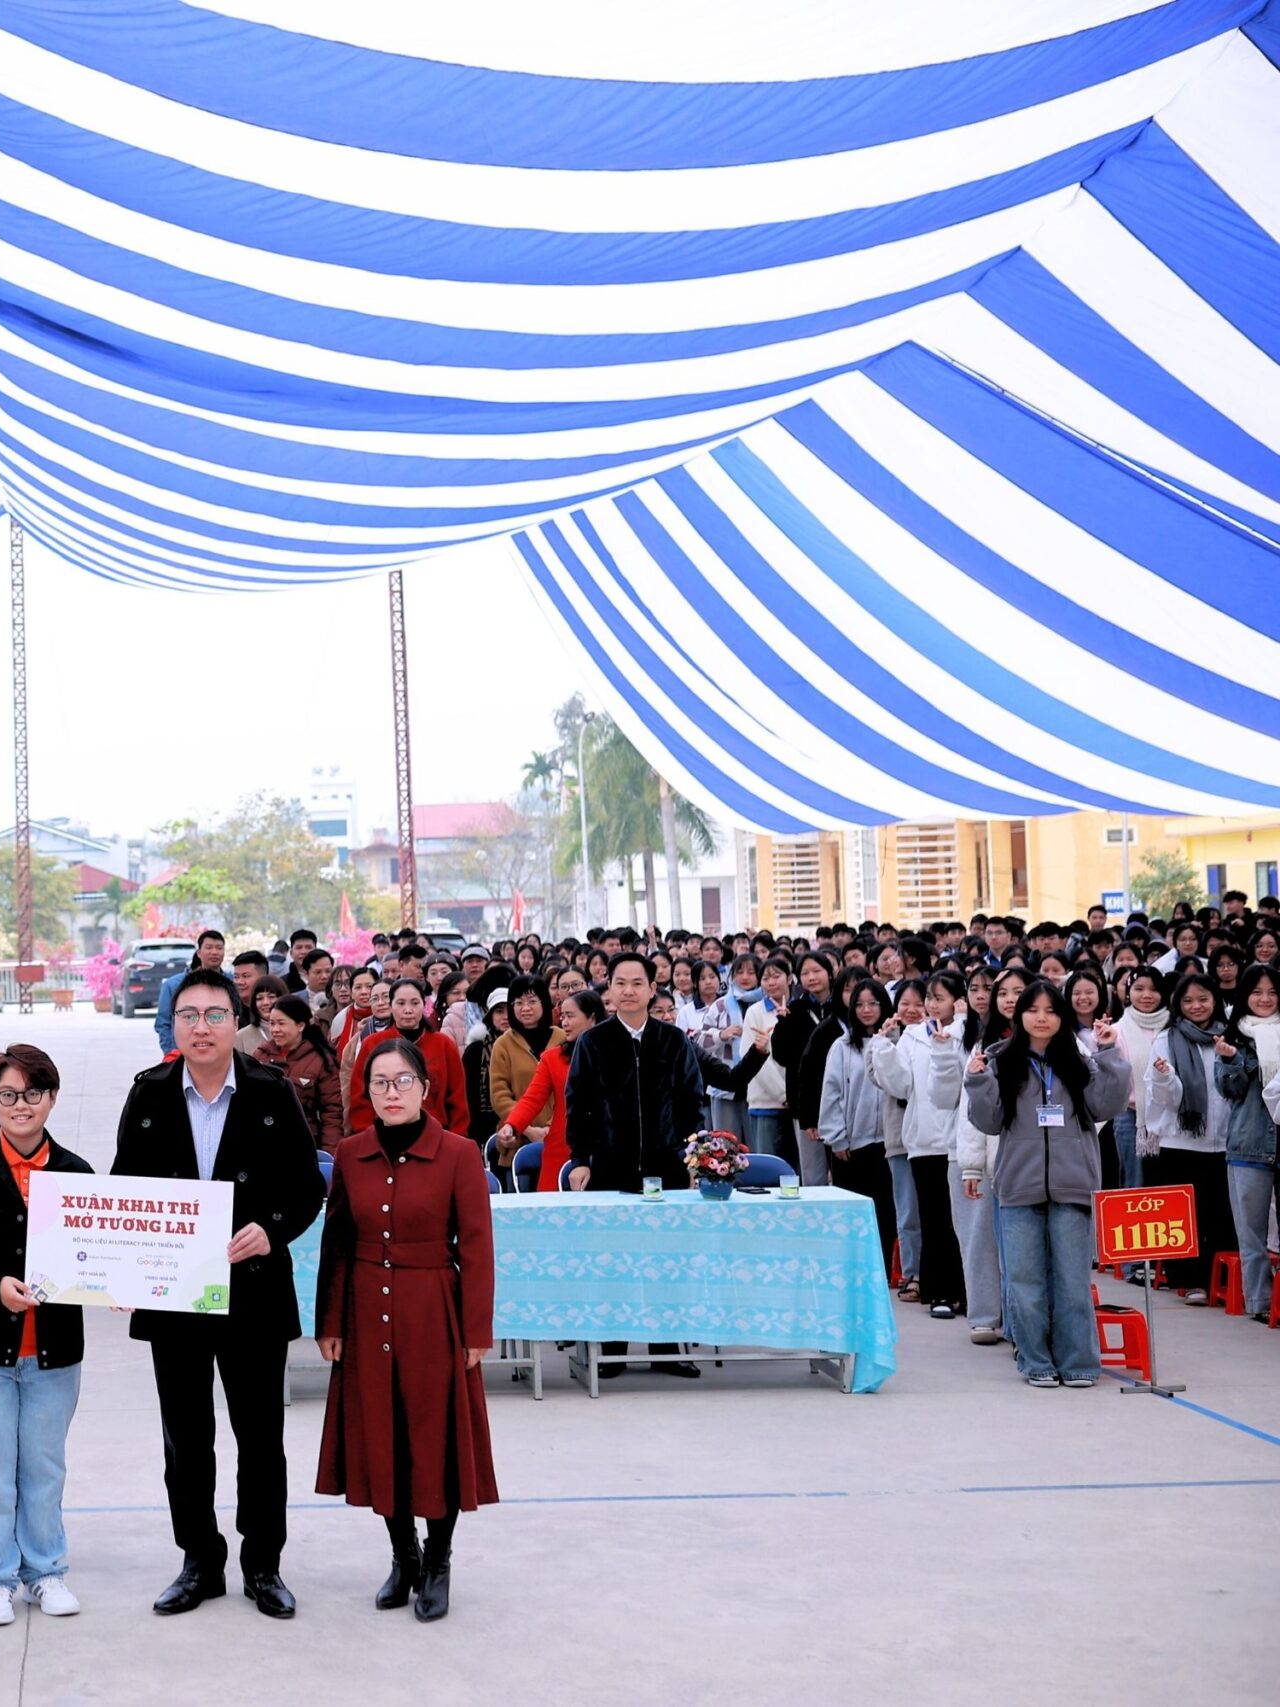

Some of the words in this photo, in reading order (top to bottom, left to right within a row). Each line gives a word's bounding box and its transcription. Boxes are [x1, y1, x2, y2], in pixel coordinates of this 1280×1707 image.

[61, 1193, 114, 1210] XUÂN
[117, 1198, 164, 1213] KHAI
[167, 1199, 200, 1216] TRÍ
[1125, 1196, 1165, 1213] LỚP
[63, 1212, 94, 1229] MỞ
[97, 1217, 161, 1233] TƯƠNG
[165, 1220, 195, 1235] LAI
[115, 1239, 141, 1247] LITERACY
[1111, 1219, 1186, 1252] 11B5
[136, 1256, 179, 1269] Google.org
